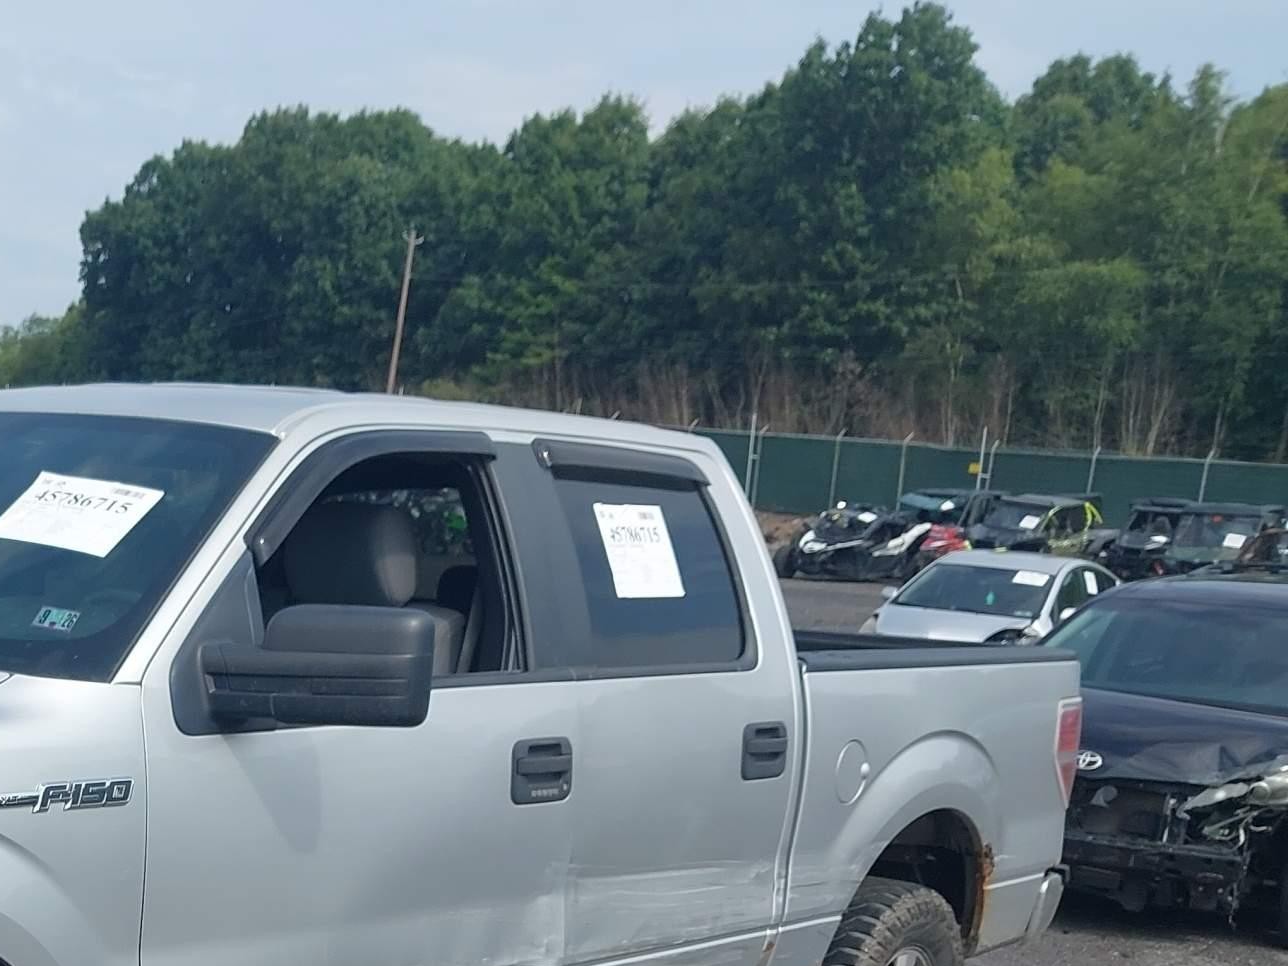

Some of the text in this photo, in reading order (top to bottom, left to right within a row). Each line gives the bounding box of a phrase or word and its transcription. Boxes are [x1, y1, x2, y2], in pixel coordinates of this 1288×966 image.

[34, 489, 134, 514] 45786715
[610, 526, 661, 543] 45786715
[38, 609, 79, 629] 9 26
[32, 778, 135, 813] F-150
